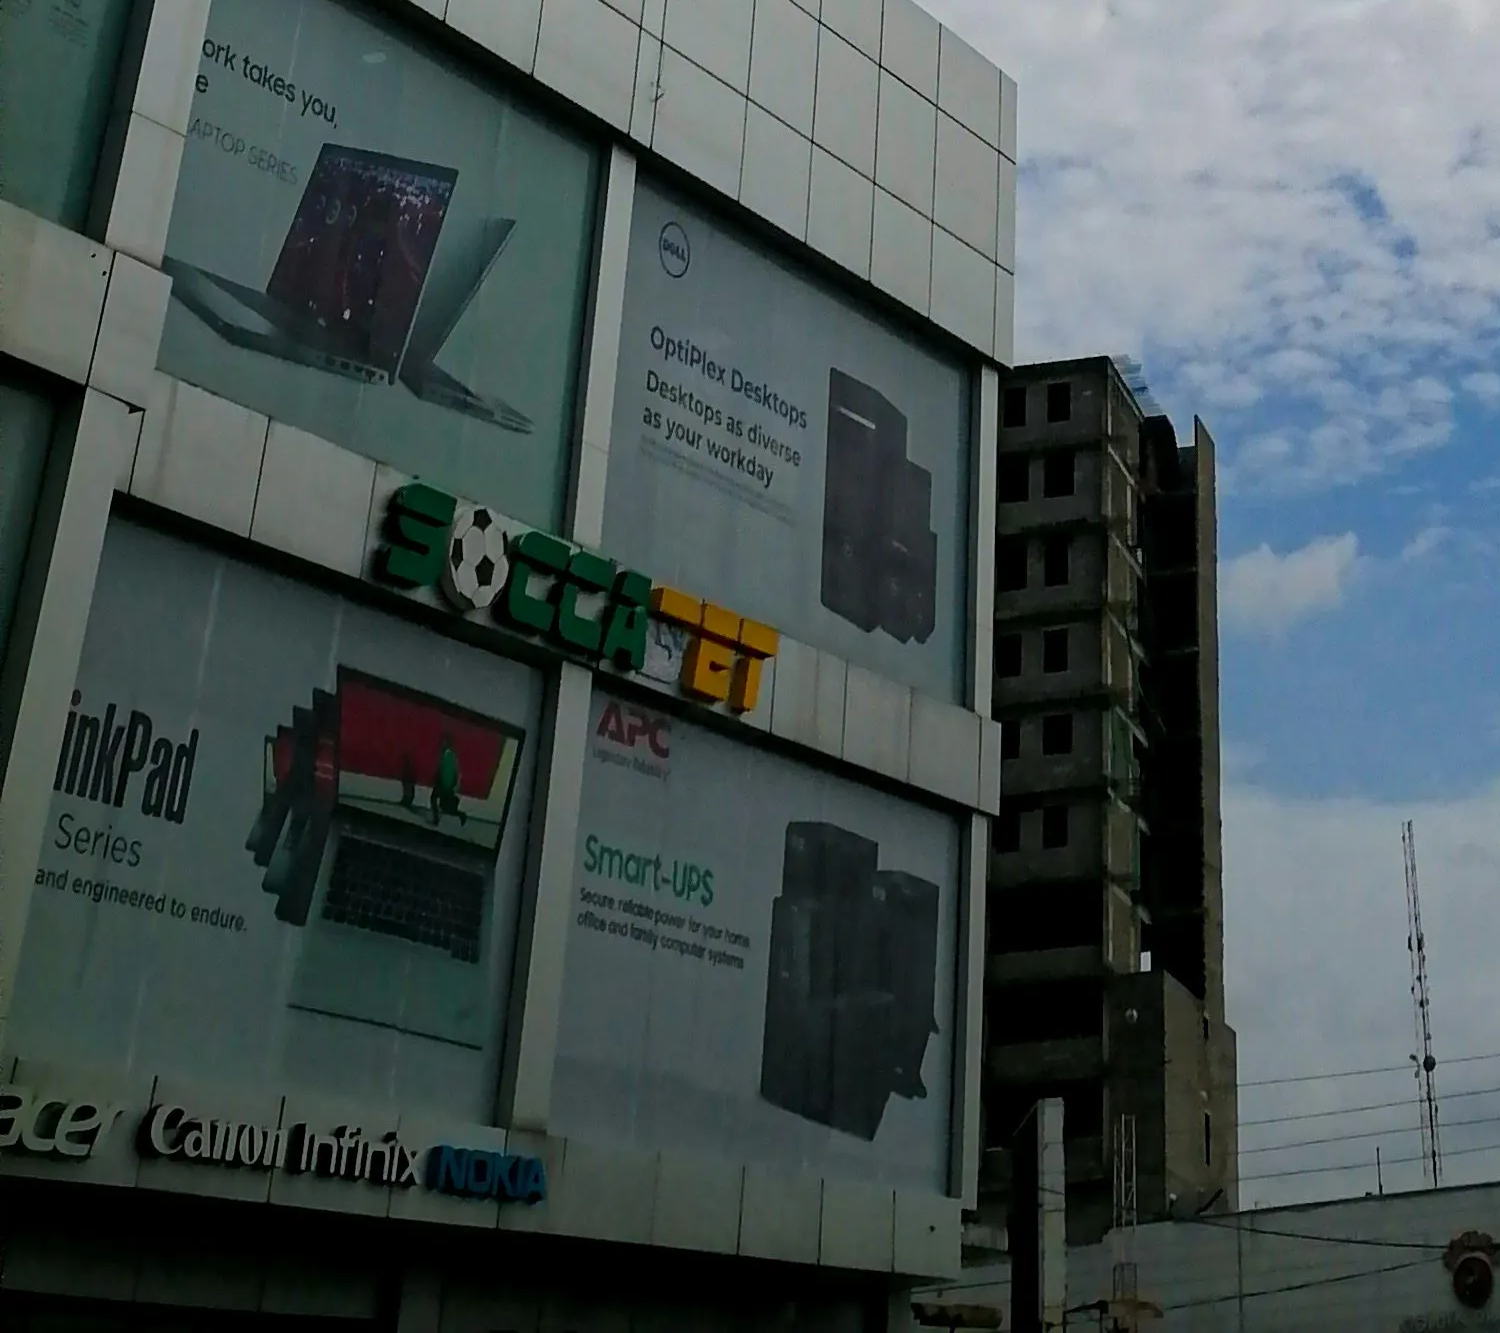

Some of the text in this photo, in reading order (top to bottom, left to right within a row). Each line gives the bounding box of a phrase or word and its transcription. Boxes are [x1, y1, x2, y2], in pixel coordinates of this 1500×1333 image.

[202, 39, 337, 129] ork takes you,
[248, 145, 299, 184] SERIES
[662, 236, 687, 263] DELL
[650, 326, 807, 429] OptiPlex Desktops
[643, 407, 774, 488] as your workday
[646, 370, 801, 467] Desktops as diverse
[596, 701, 670, 759] APC
[54, 813, 142, 867] Series
[584, 834, 714, 907] Smart-UPS
[35, 868, 247, 933] and engineered to endure.
[655, 910, 686, 929] power
[688, 915, 702, 932] for
[577, 910, 606, 933] office
[608, 919, 628, 937] and
[660, 935, 706, 959] computer
[708, 948, 744, 970] systems
[0, 1088, 130, 1156] acer
[150, 1104, 545, 1202] Canon Infinix NOKIA
